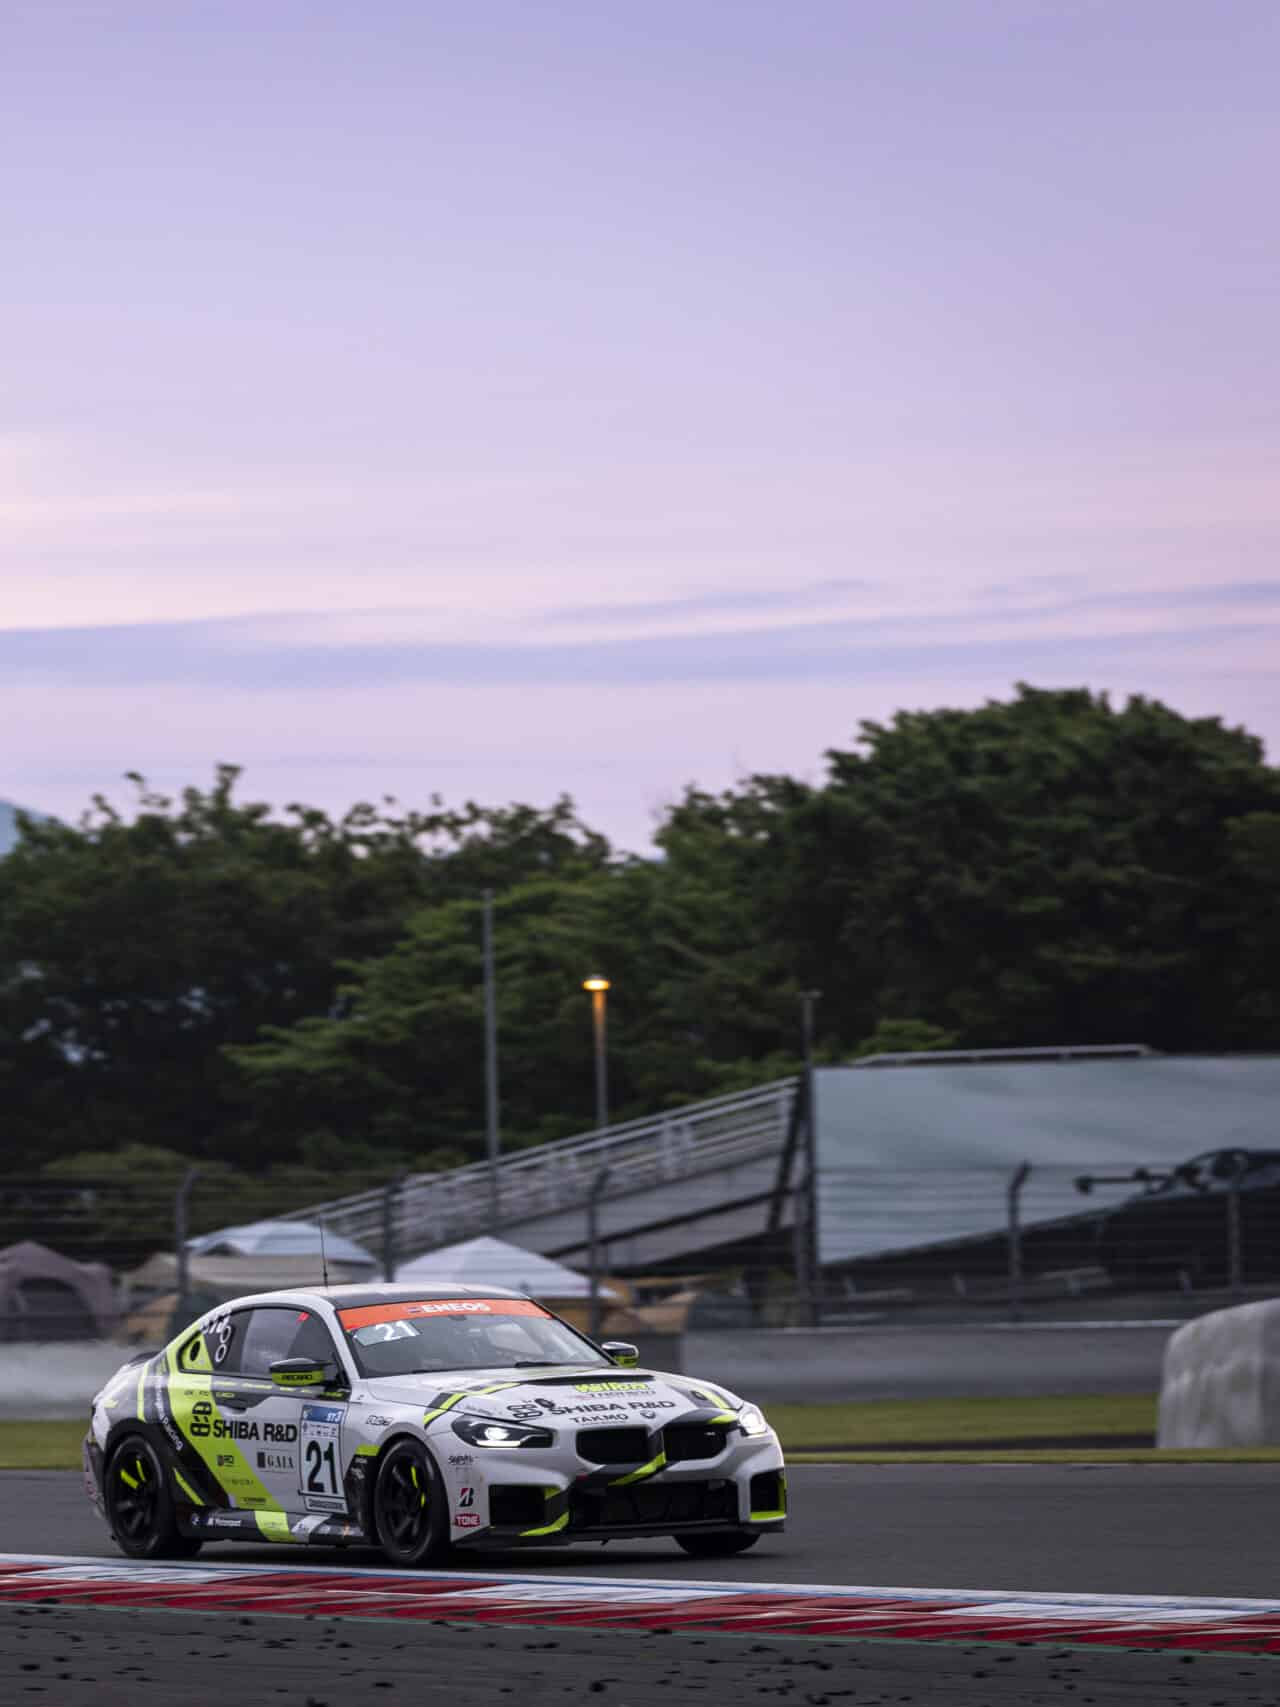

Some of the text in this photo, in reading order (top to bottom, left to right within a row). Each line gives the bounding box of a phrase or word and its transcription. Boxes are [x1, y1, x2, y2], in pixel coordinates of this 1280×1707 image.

[422, 1302, 491, 1313] ENEOS
[375, 1320, 417, 1341] 21
[550, 1400, 676, 1415] SHIBA R&D
[570, 1413, 629, 1424] TAKMO
[213, 1419, 259, 1441] SHIBA
[263, 1422, 298, 1442] R&D
[306, 1440, 338, 1494] 21
